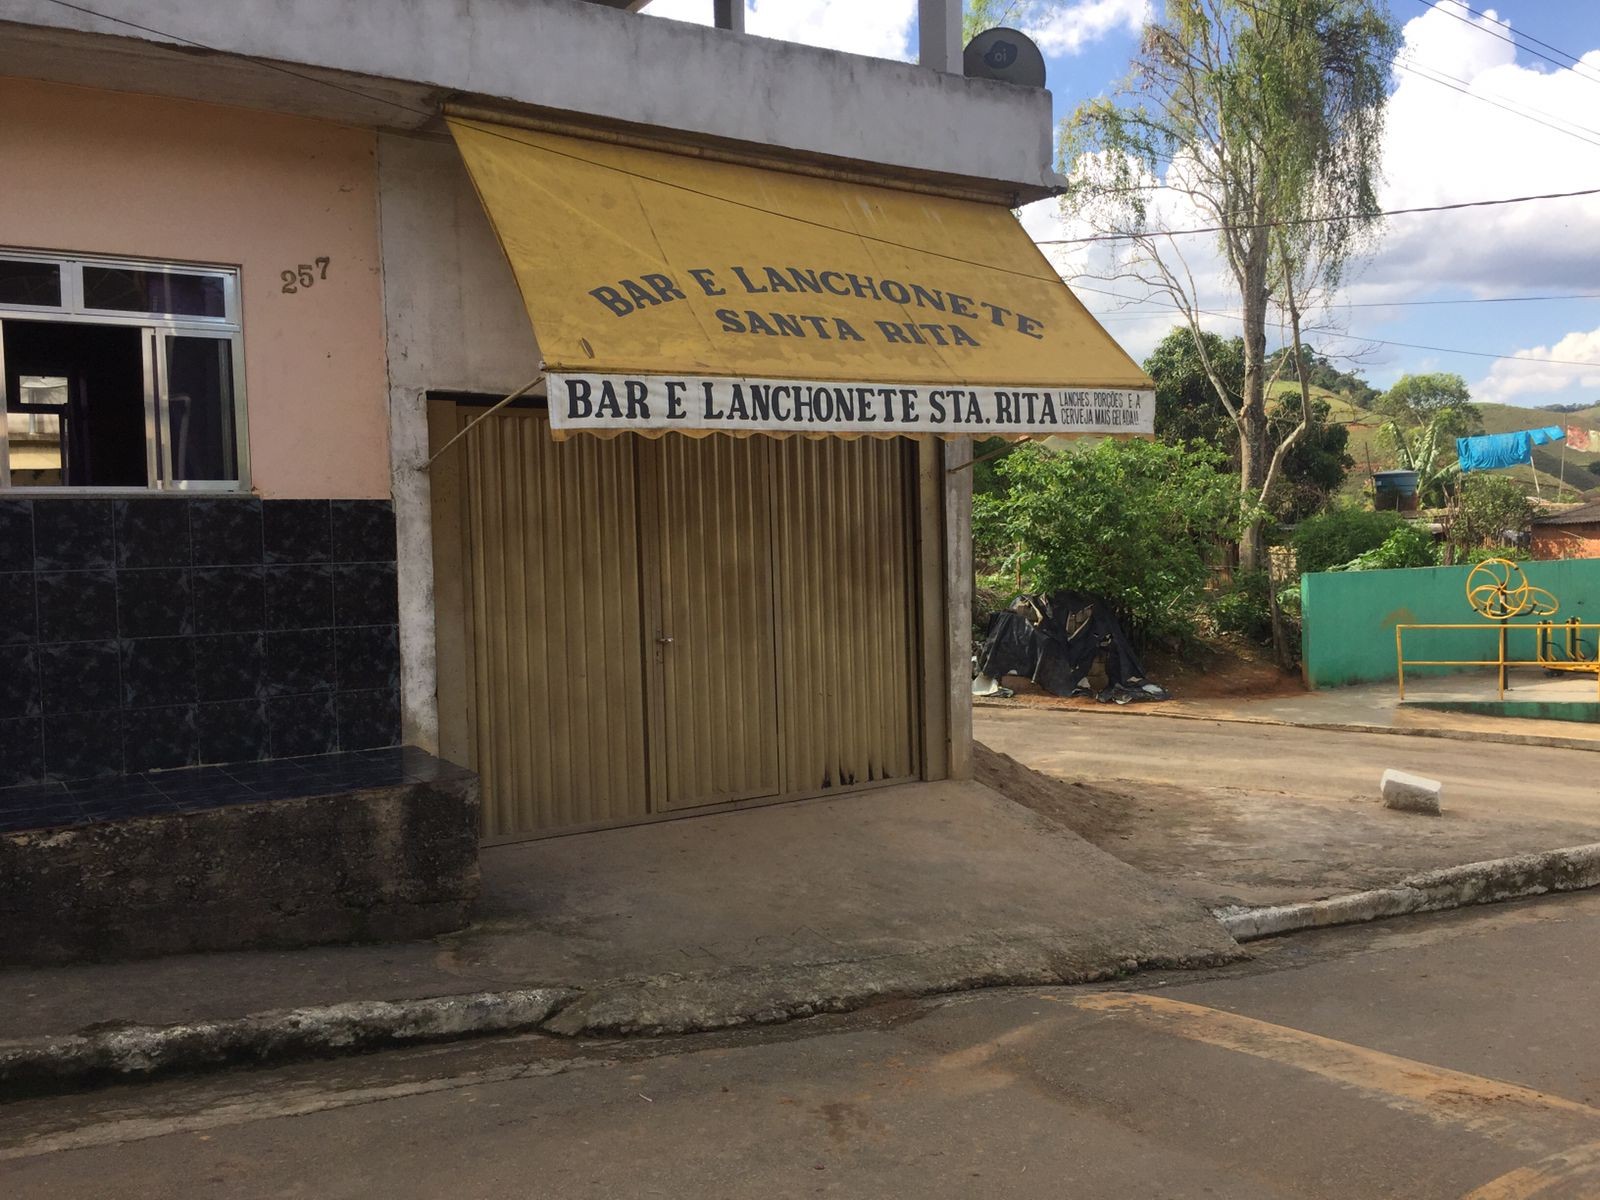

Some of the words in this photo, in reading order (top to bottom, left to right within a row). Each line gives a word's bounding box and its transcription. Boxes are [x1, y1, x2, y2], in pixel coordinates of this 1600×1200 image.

[280, 256, 330, 294] 257
[588, 273, 687, 318] BAR
[687, 268, 727, 297] E
[730, 266, 1045, 340] LANCHONETE
[714, 308, 866, 342] SANTA
[873, 320, 982, 347] RITA
[565, 379, 651, 419] BAR
[664, 381, 688, 420] E
[701, 381, 920, 424] LANCHONETE
[929, 390, 991, 425] STA.
[994, 391, 1058, 425] RITA
[1061, 408, 1093, 425] CERVEJA
[1095, 409, 1110, 425] MAIS
[1127, 393, 1133, 408] E
[1135, 394, 1141, 409] A
